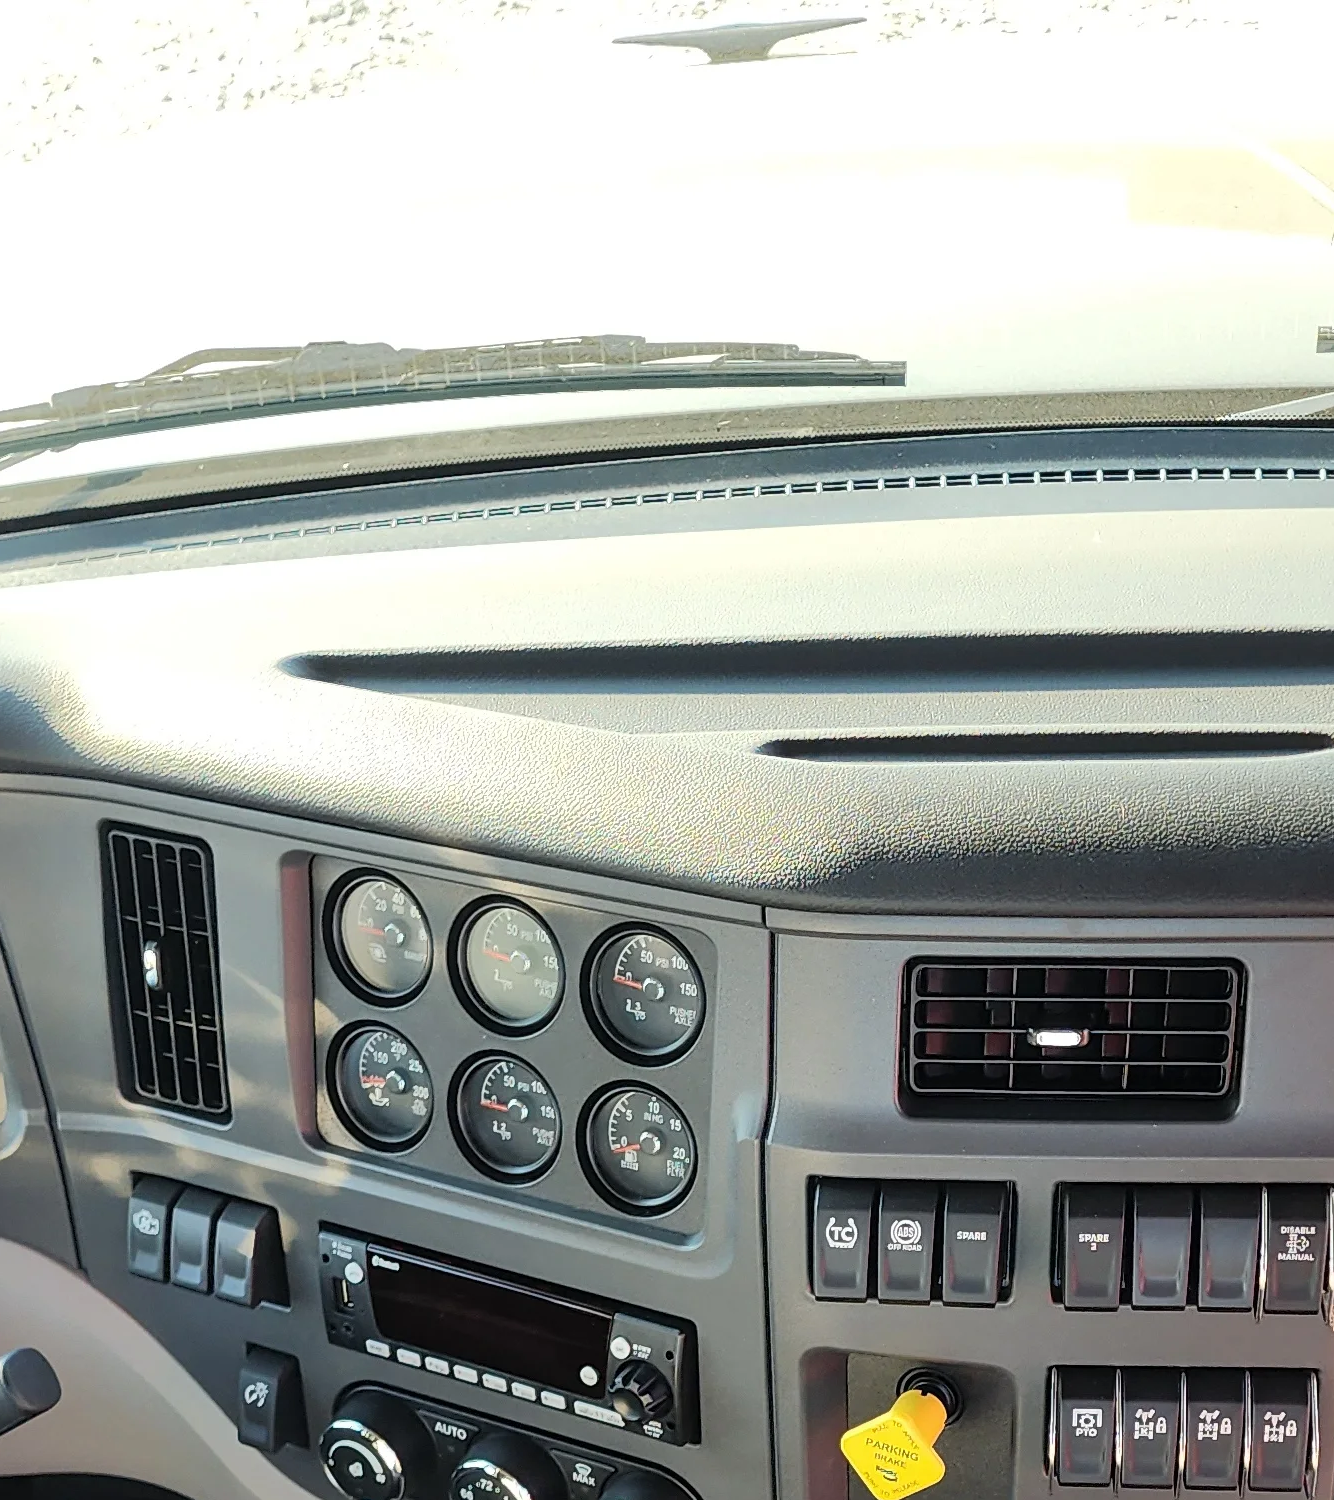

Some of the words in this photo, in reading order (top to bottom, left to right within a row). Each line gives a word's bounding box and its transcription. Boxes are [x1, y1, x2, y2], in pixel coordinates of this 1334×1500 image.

[375, 899, 387, 912] 20
[507, 924, 518, 937] 50
[640, 950, 653, 964] 50
[655, 957, 669, 969] PSI
[680, 982, 697, 997] 150
[503, 1075, 515, 1088] 50
[648, 1102, 660, 1114] 10
[625, 1110, 633, 1121] 5
[669, 1118, 682, 1131] 15
[621, 1136, 628, 1146] 0
[673, 1147, 686, 1160] 20
[831, 1226, 853, 1242] TC
[898, 1227, 914, 1238] ABS
[957, 1231, 987, 1241] SPARE
[1281, 1226, 1316, 1235] DISABLE
[1078, 1234, 1110, 1243] SPARE
[1278, 1253, 1315, 1262] MANUAL
[893, 1420, 902, 1428] TO
[435, 1422, 467, 1441] AUTO
[1075, 1428, 1098, 1437] PTO
[865, 1438, 919, 1462] PARKING
[875, 1452, 907, 1469] BRAKE
[479, 1478, 493, 1491] 72
[573, 1472, 596, 1487] MAX
